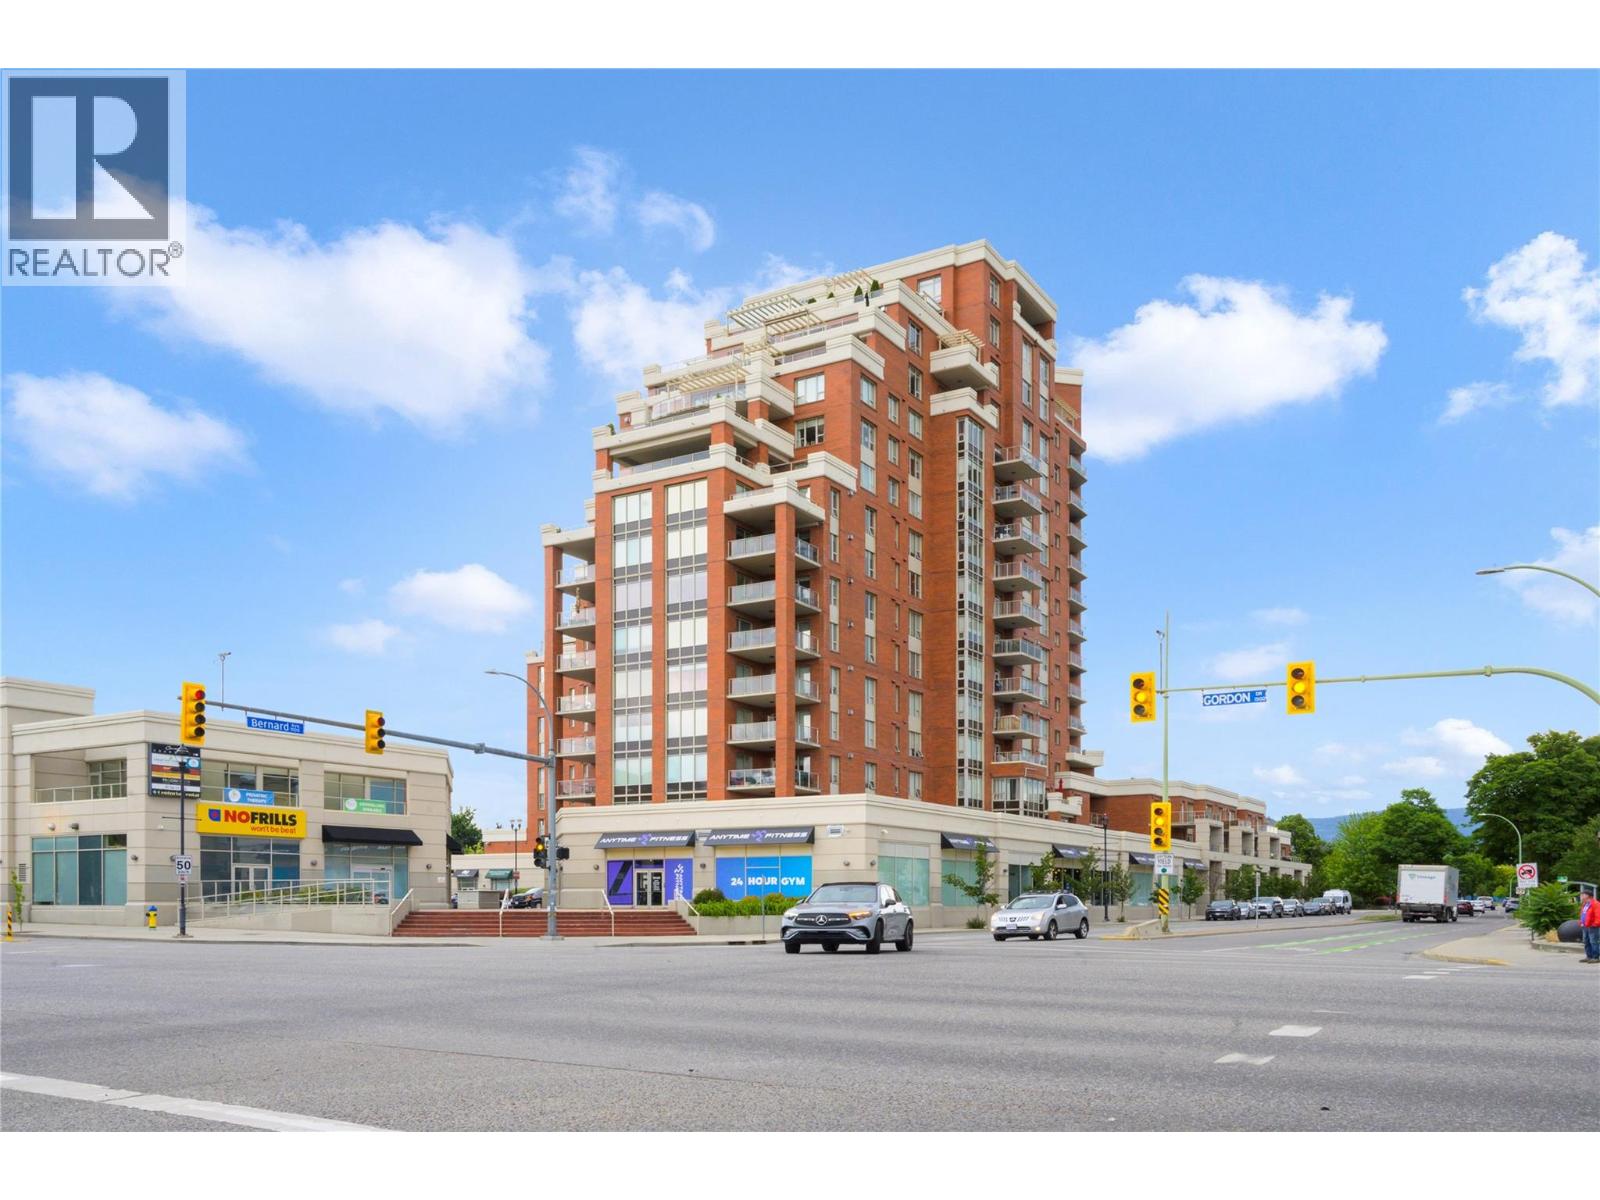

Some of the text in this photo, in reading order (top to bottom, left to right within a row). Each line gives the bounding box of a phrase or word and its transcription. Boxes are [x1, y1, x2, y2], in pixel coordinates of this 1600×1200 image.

[1203, 692, 1251, 706] GORDON
[251, 719, 289, 732] Bernard
[271, 826, 280, 834] be
[764, 831, 808, 839] FITNESS
[176, 860, 191, 870] 50
[730, 876, 806, 886] 24 HOUR GYM
